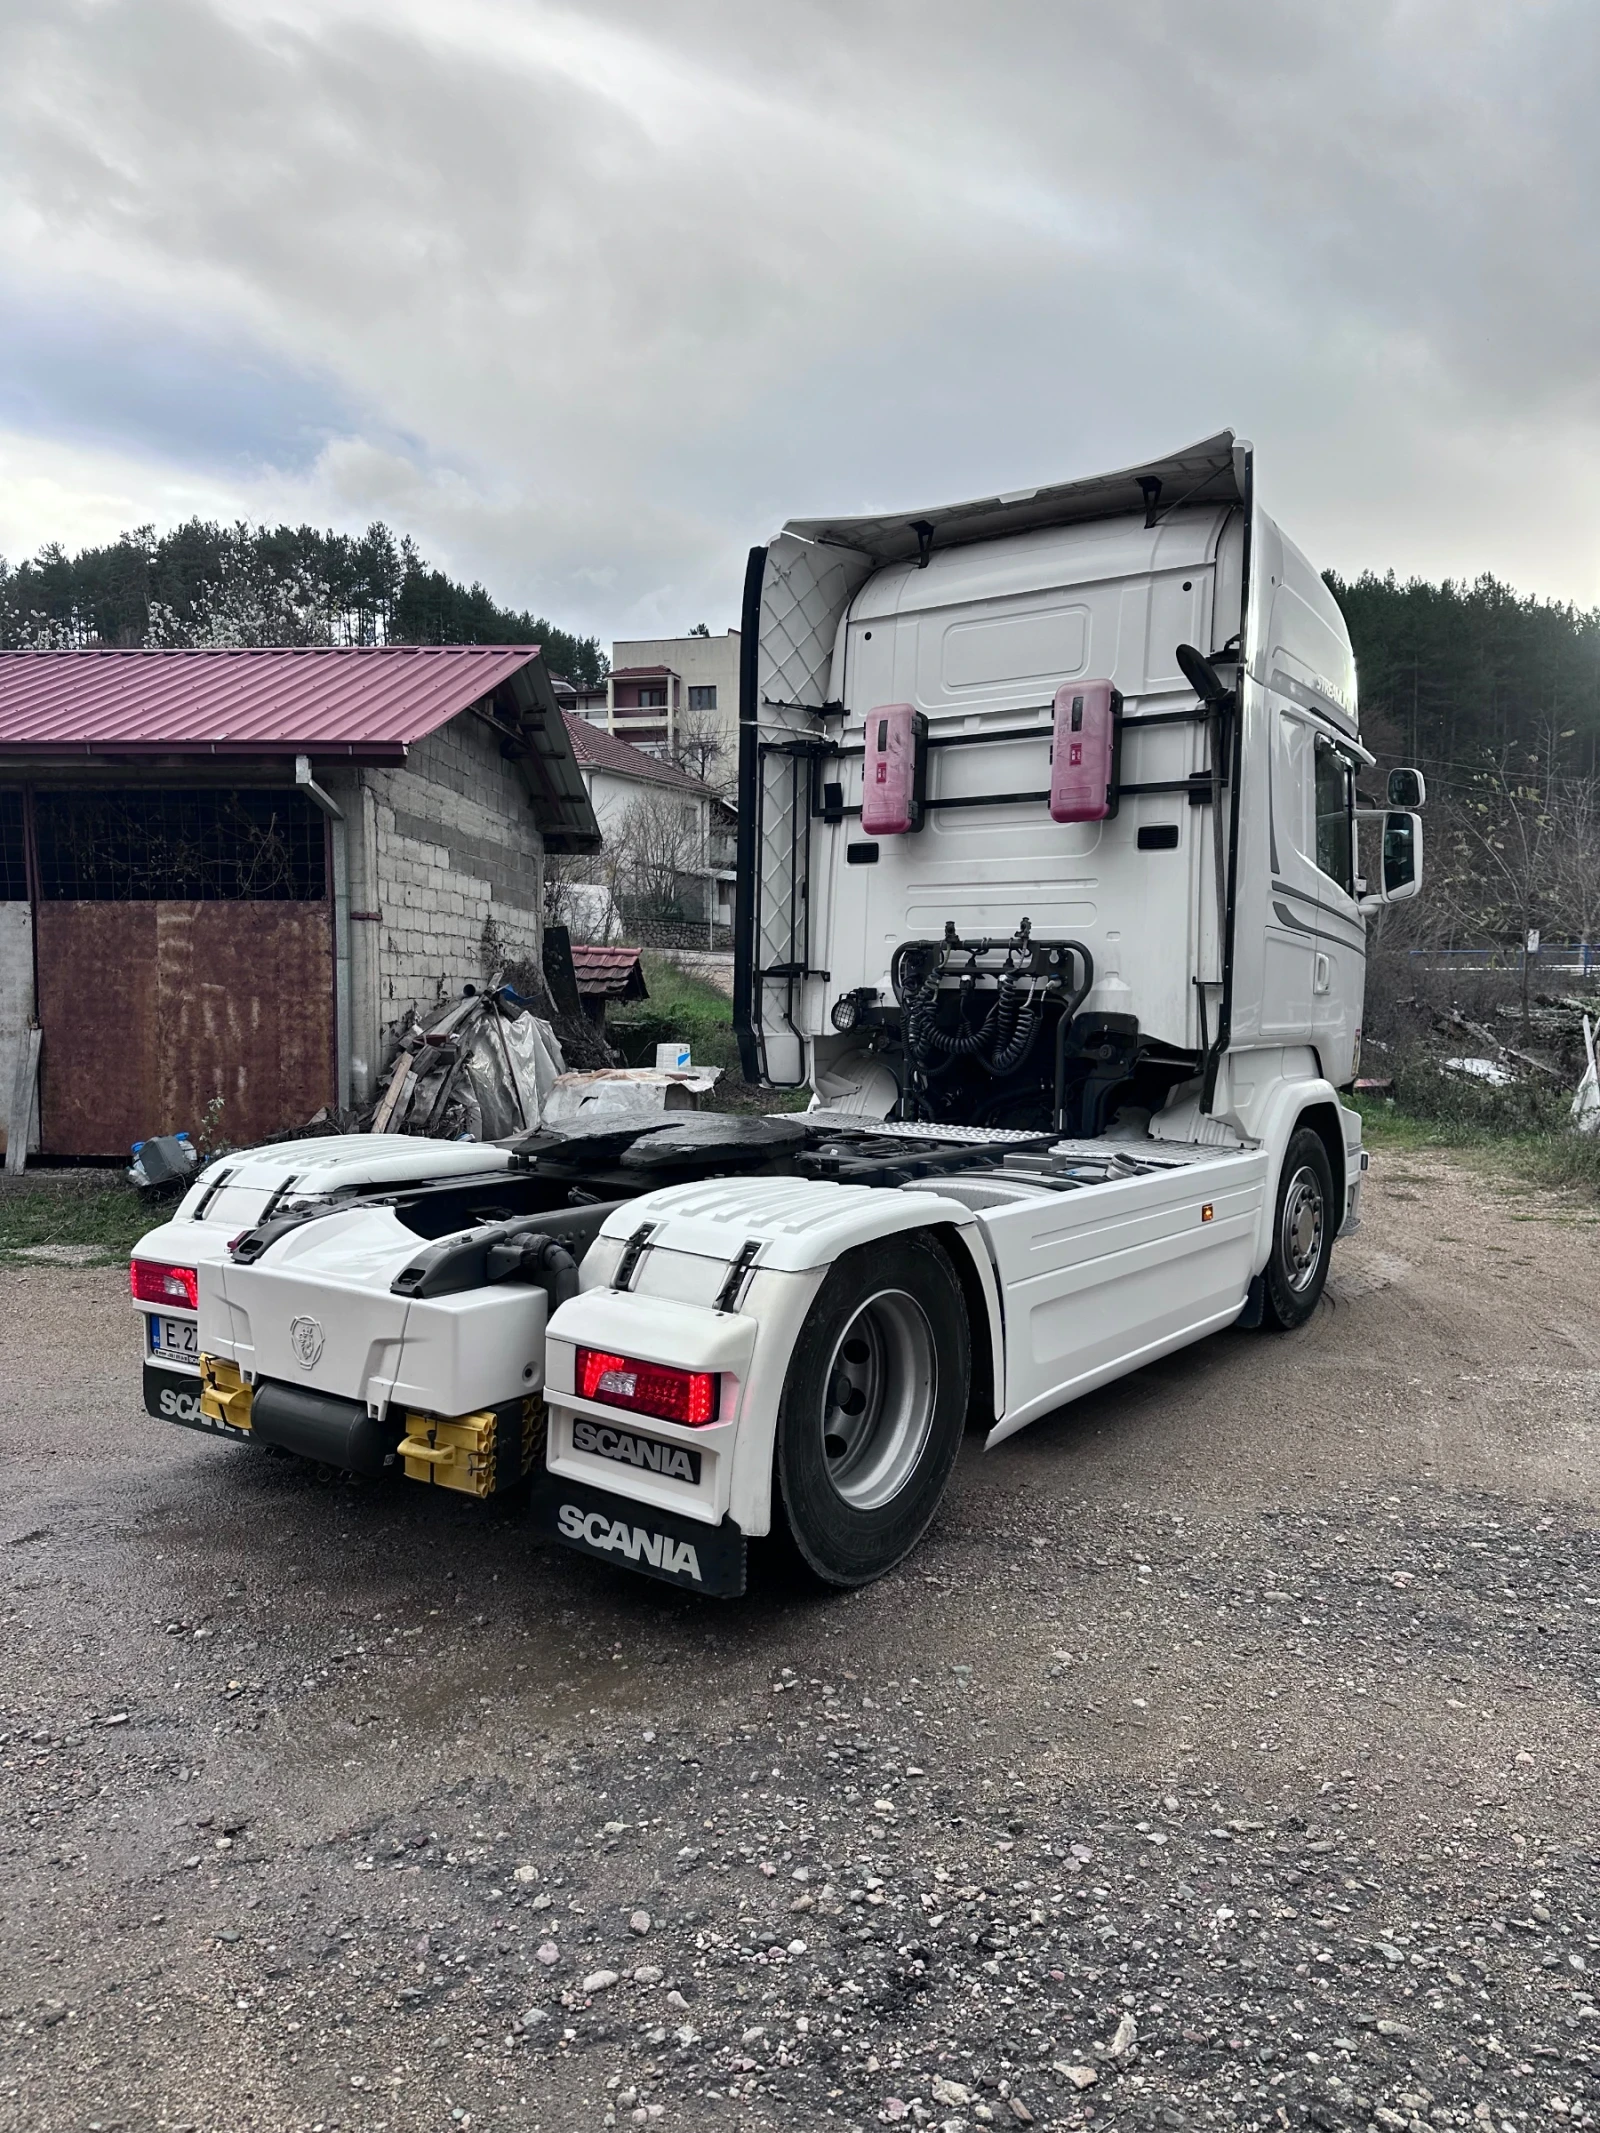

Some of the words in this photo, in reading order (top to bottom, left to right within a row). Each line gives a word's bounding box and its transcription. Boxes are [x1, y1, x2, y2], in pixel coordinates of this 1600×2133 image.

[159, 1388, 250, 1437] SCA
[573, 1422, 694, 1482] SCANIA
[557, 1503, 703, 1581] SCANIA
